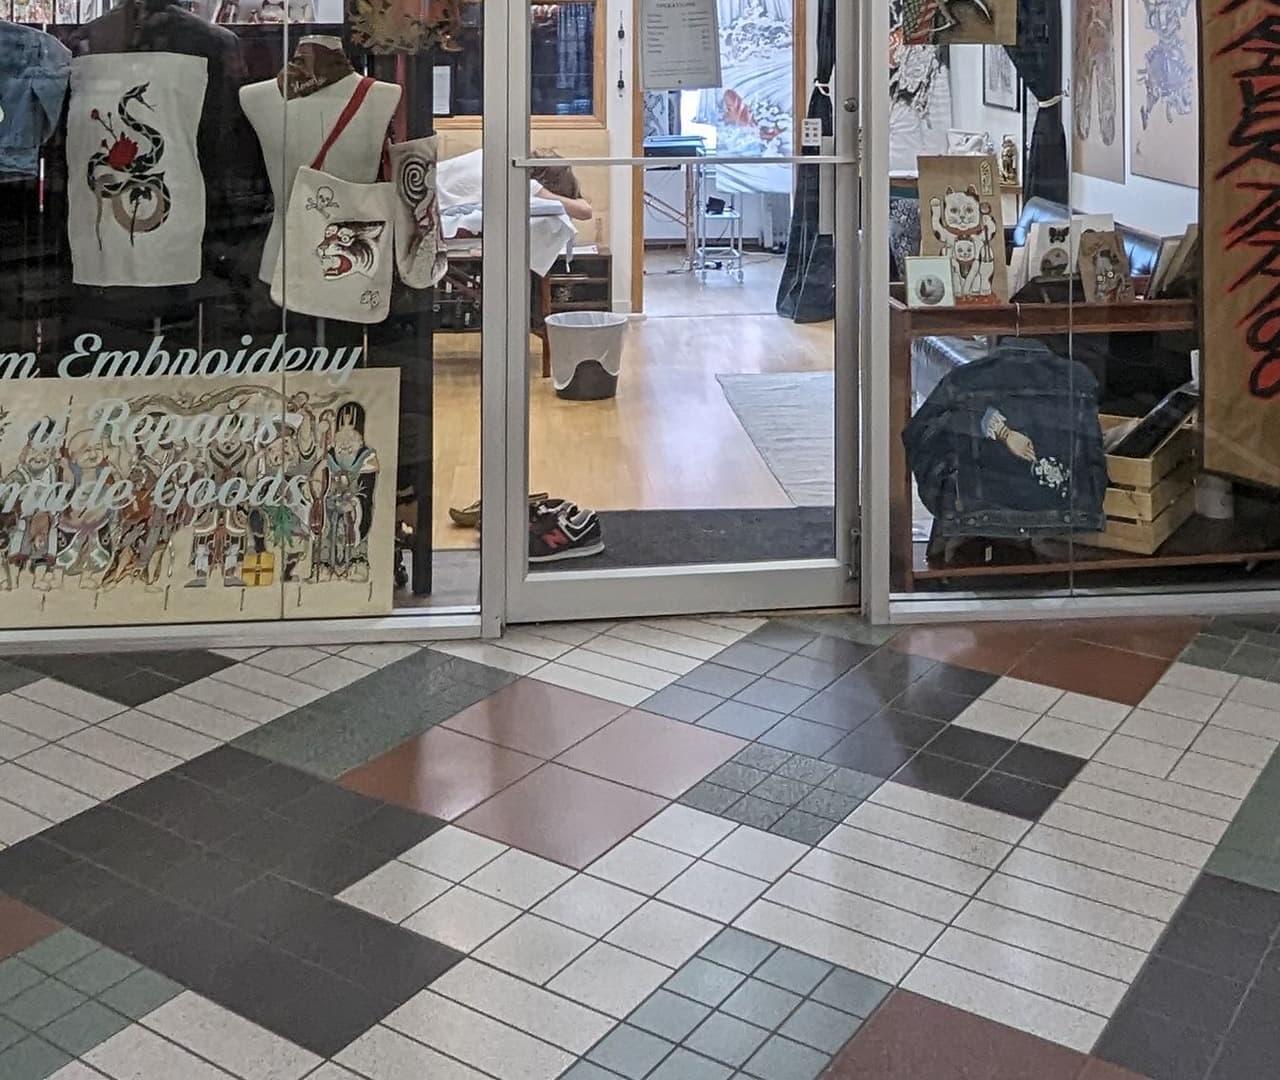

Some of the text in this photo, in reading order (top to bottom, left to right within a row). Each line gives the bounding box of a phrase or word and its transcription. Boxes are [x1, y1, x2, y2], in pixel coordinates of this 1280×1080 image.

[57, 332, 364, 388] Embroidery
[88, 398, 283, 454] Repairs
[153, 461, 311, 513] Goods
